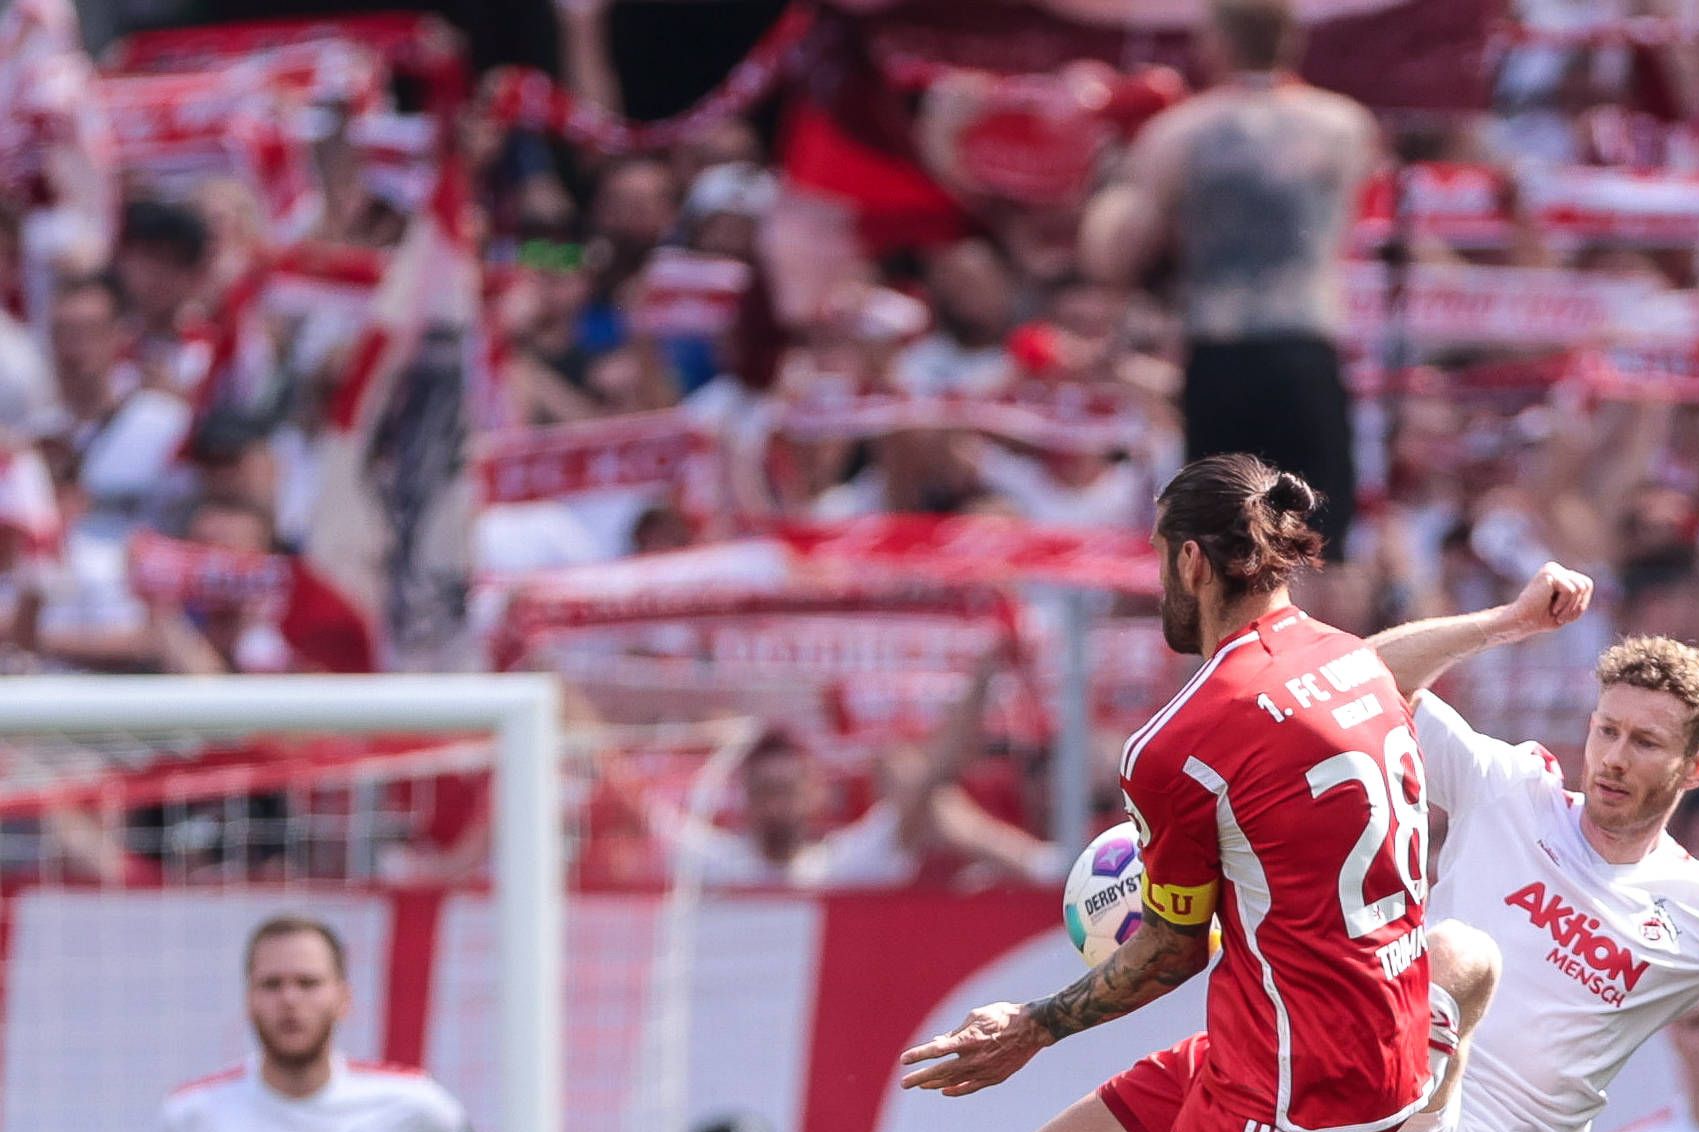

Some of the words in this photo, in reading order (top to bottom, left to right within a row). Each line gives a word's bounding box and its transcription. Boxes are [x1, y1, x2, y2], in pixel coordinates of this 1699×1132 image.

[1284, 673, 1332, 709] FC
[1305, 724, 1429, 939] 28
[1545, 948, 1626, 1008] MENSCH
